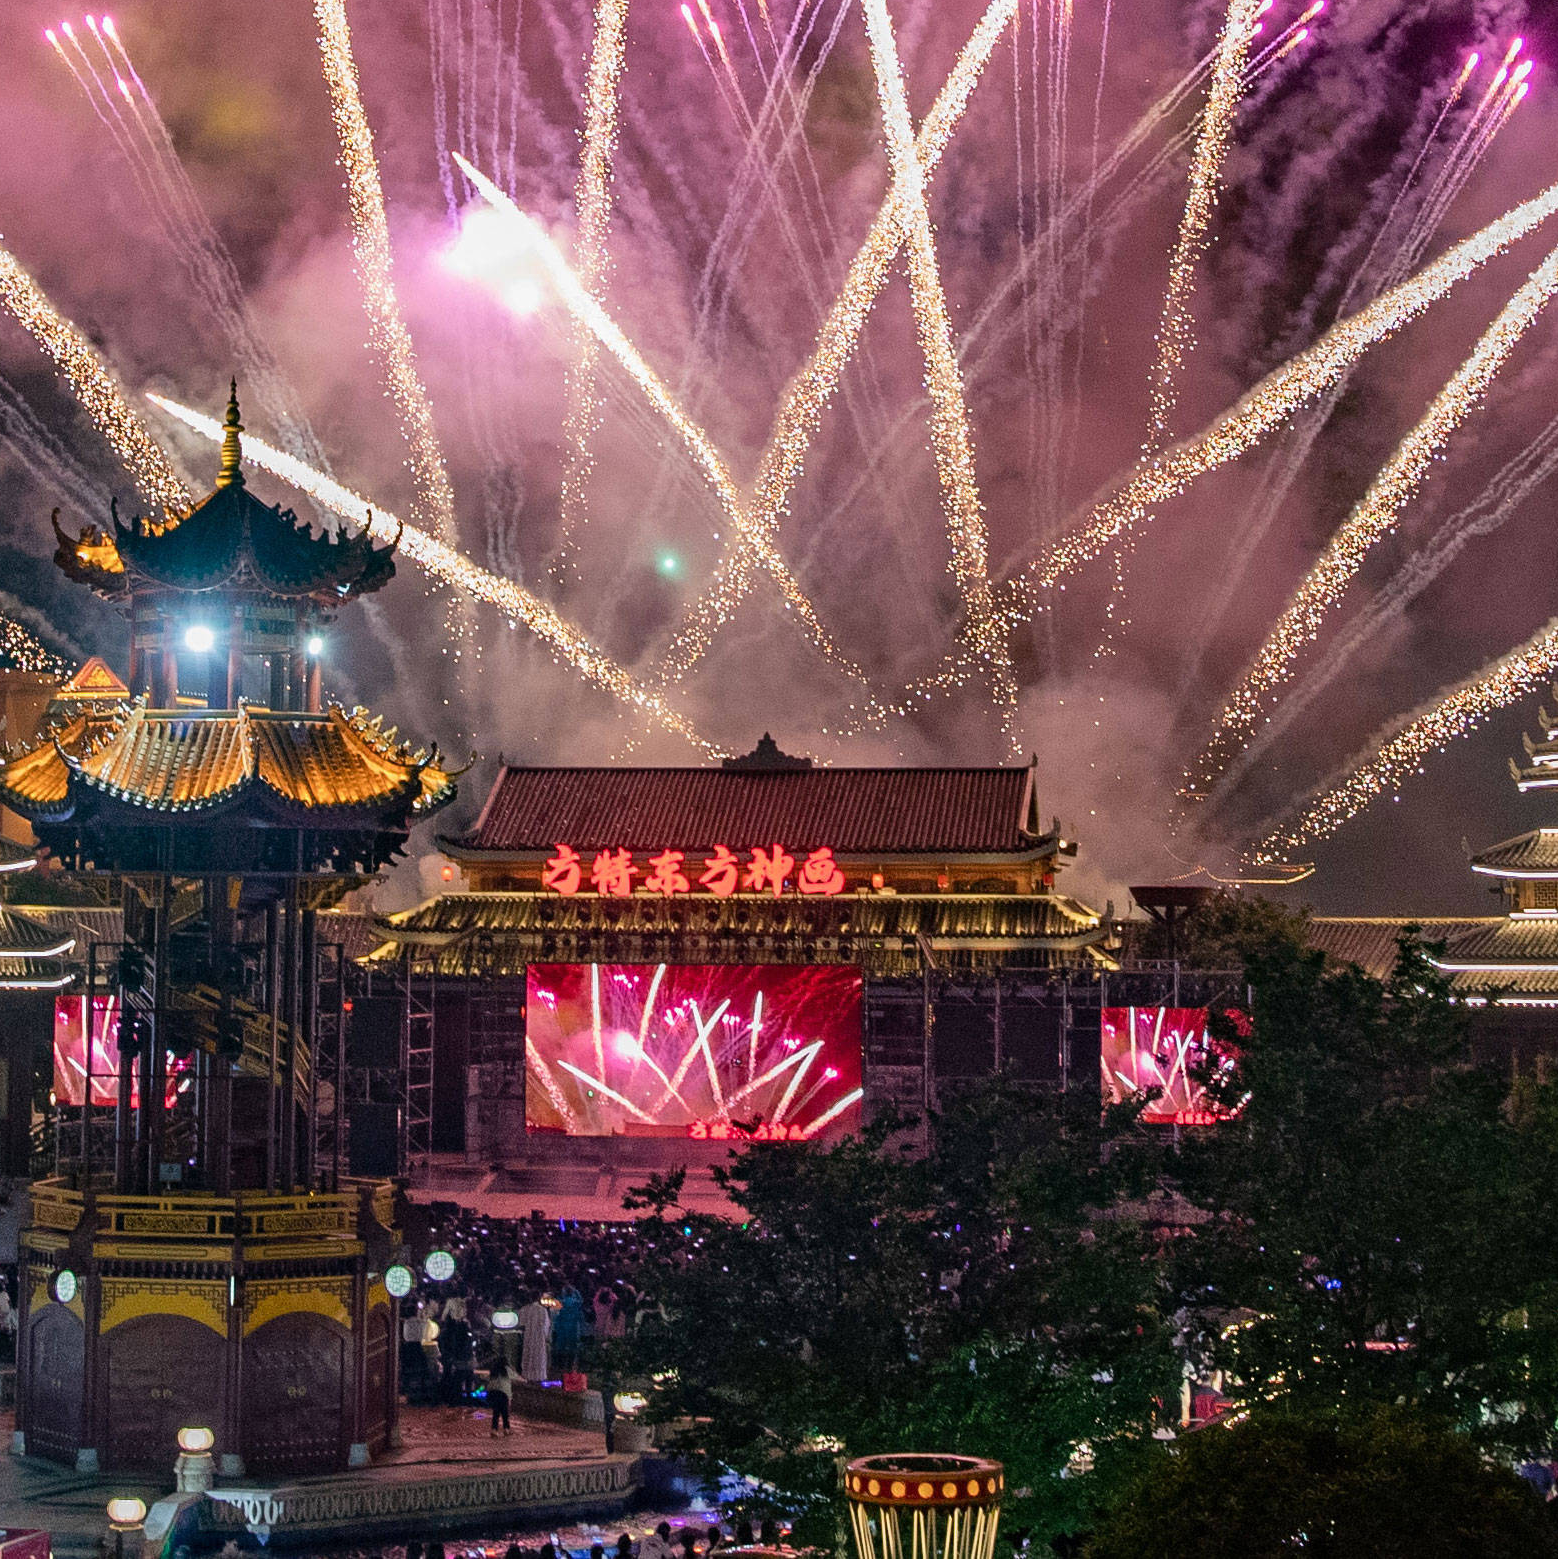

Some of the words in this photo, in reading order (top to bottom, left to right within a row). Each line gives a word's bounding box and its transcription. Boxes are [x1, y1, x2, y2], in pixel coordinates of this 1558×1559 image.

[543, 843, 845, 898] 方特东方神画
